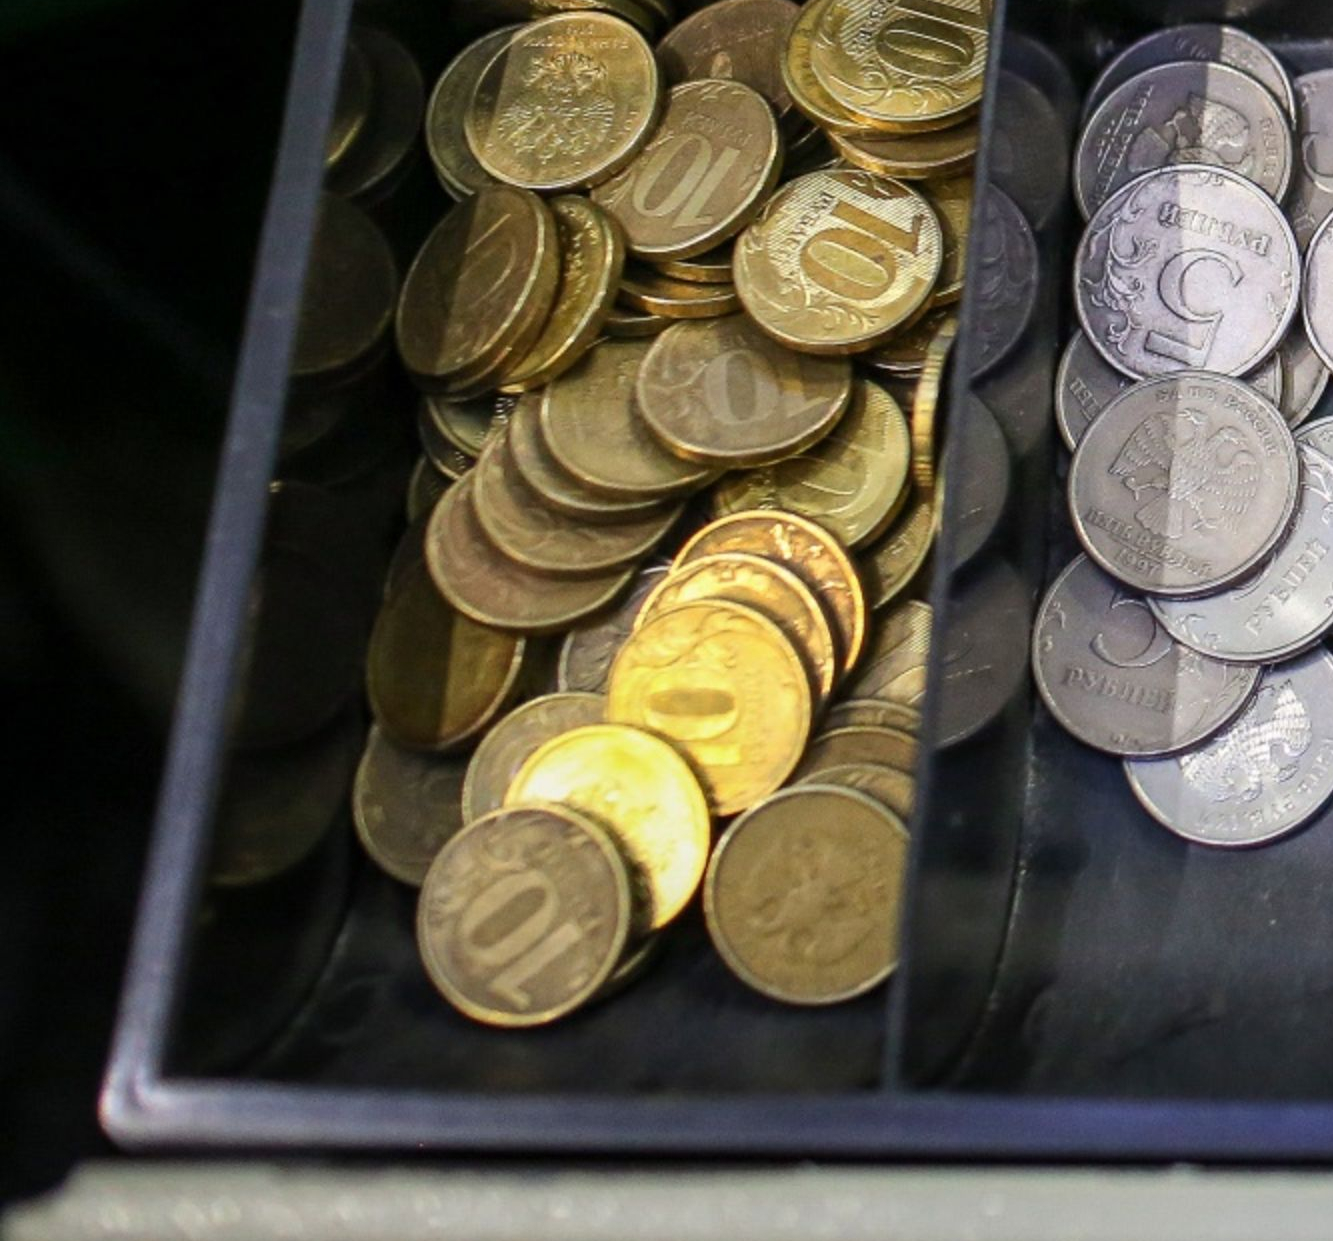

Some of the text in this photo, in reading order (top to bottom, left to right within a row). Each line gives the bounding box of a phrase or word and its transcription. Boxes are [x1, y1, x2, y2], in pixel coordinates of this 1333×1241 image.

[634, 133, 742, 229] 10
[1156, 202, 1273, 257] РУБЛЕЙ
[801, 200, 926, 302] 10
[1144, 247, 1245, 368] 5
[1244, 537, 1331, 637] РУБЛЕЙ
[1063, 666, 1177, 713] РУБЛЕЙ
[460, 867, 586, 1010] 10
